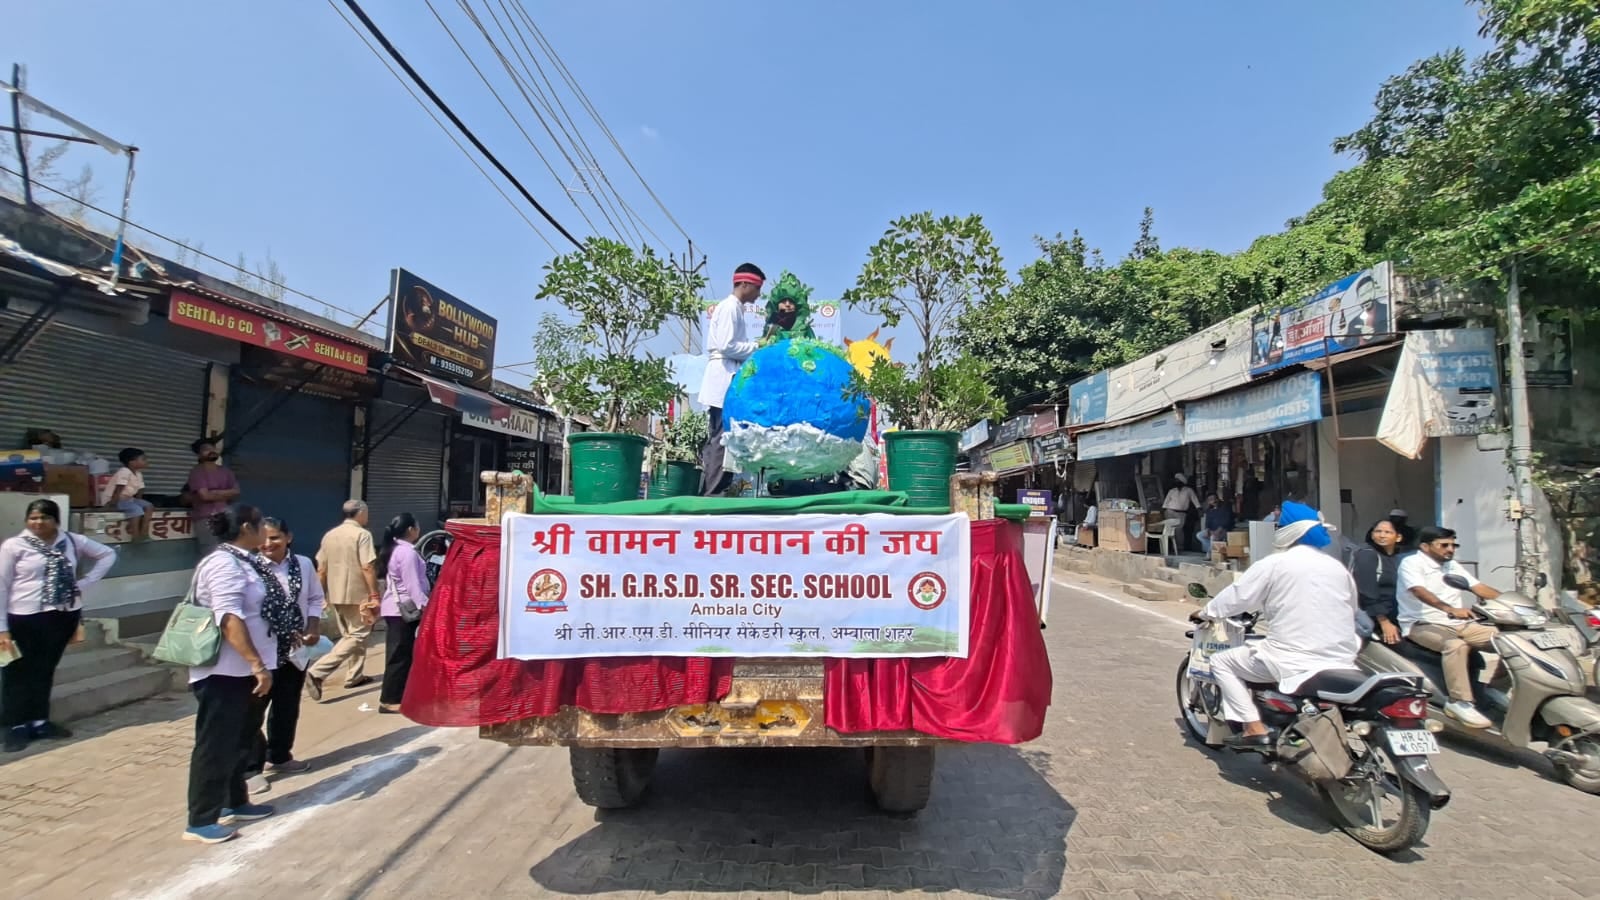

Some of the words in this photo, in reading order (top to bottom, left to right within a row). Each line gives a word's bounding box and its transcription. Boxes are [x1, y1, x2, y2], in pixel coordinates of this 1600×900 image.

[177, 301, 225, 327] SEHTAJ
[227, 316, 235, 328] &
[238, 319, 256, 336] CO.
[438, 299, 494, 340] BOLLYWOOD
[453, 326, 479, 349] HUB
[314, 342, 346, 361] SEHTAJ
[352, 353, 366, 367] CO.
[531, 523, 575, 555] श्री
[585, 530, 681, 555] वामन
[693, 530, 814, 555] भगवान
[822, 523, 870, 555] की
[879, 530, 943, 555] जय
[579, 573, 616, 598] SH.
[622, 573, 704, 598] G.R.S.D.
[710, 573, 745, 598] SR.
[750, 574, 798, 598] SEC.
[803, 574, 892, 598] SCHOOL
[690, 603, 747, 616] Ambala
[752, 603, 782, 619] City
[554, 622, 573, 640] श्री
[683, 622, 731, 640] सीनियर
[885, 626, 914, 641] शहर
[1400, 731, 1414, 743] HR
